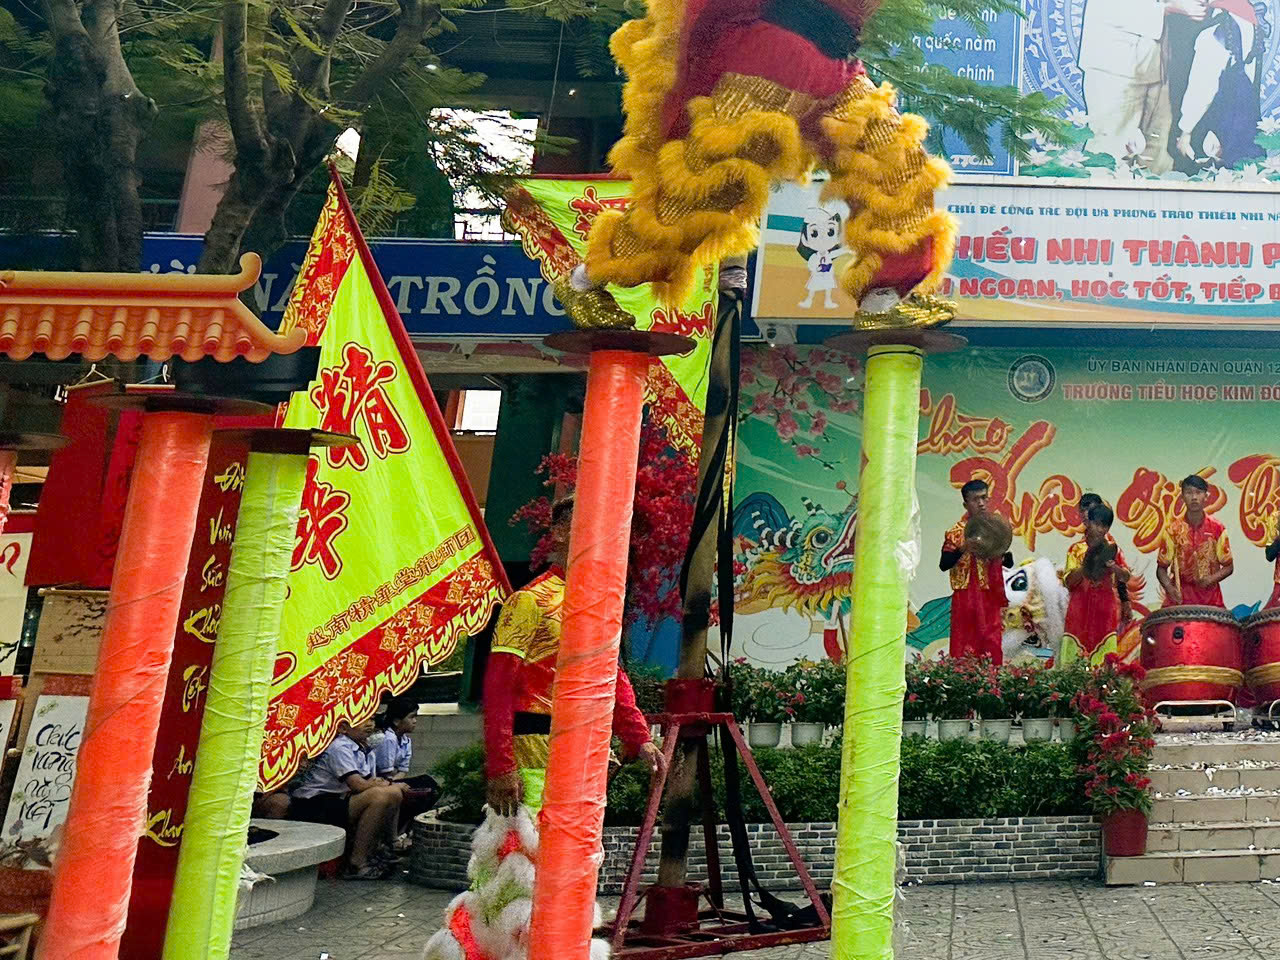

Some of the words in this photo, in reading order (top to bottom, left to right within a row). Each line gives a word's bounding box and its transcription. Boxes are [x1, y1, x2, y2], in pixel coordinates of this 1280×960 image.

[957, 64, 996, 81] chính
[1113, 208, 1157, 219] PHONG
[1240, 211, 1264, 221] NHI
[953, 226, 1037, 264] HIẾU
[1046, 238, 1113, 264] NHI
[1123, 234, 1253, 268] THÀNH
[960, 278, 1064, 301] NGOAN,
[1071, 280, 1128, 301] HỌC
[1133, 274, 1194, 303] TỐT,
[1200, 275, 1265, 303] TIẾP
[1111, 360, 1142, 373] BAN
[1146, 359, 1185, 374] NHÂN
[1190, 360, 1220, 374] DÂN
[1181, 384, 1218, 403] HỌC
[1222, 384, 1254, 401] KIM
